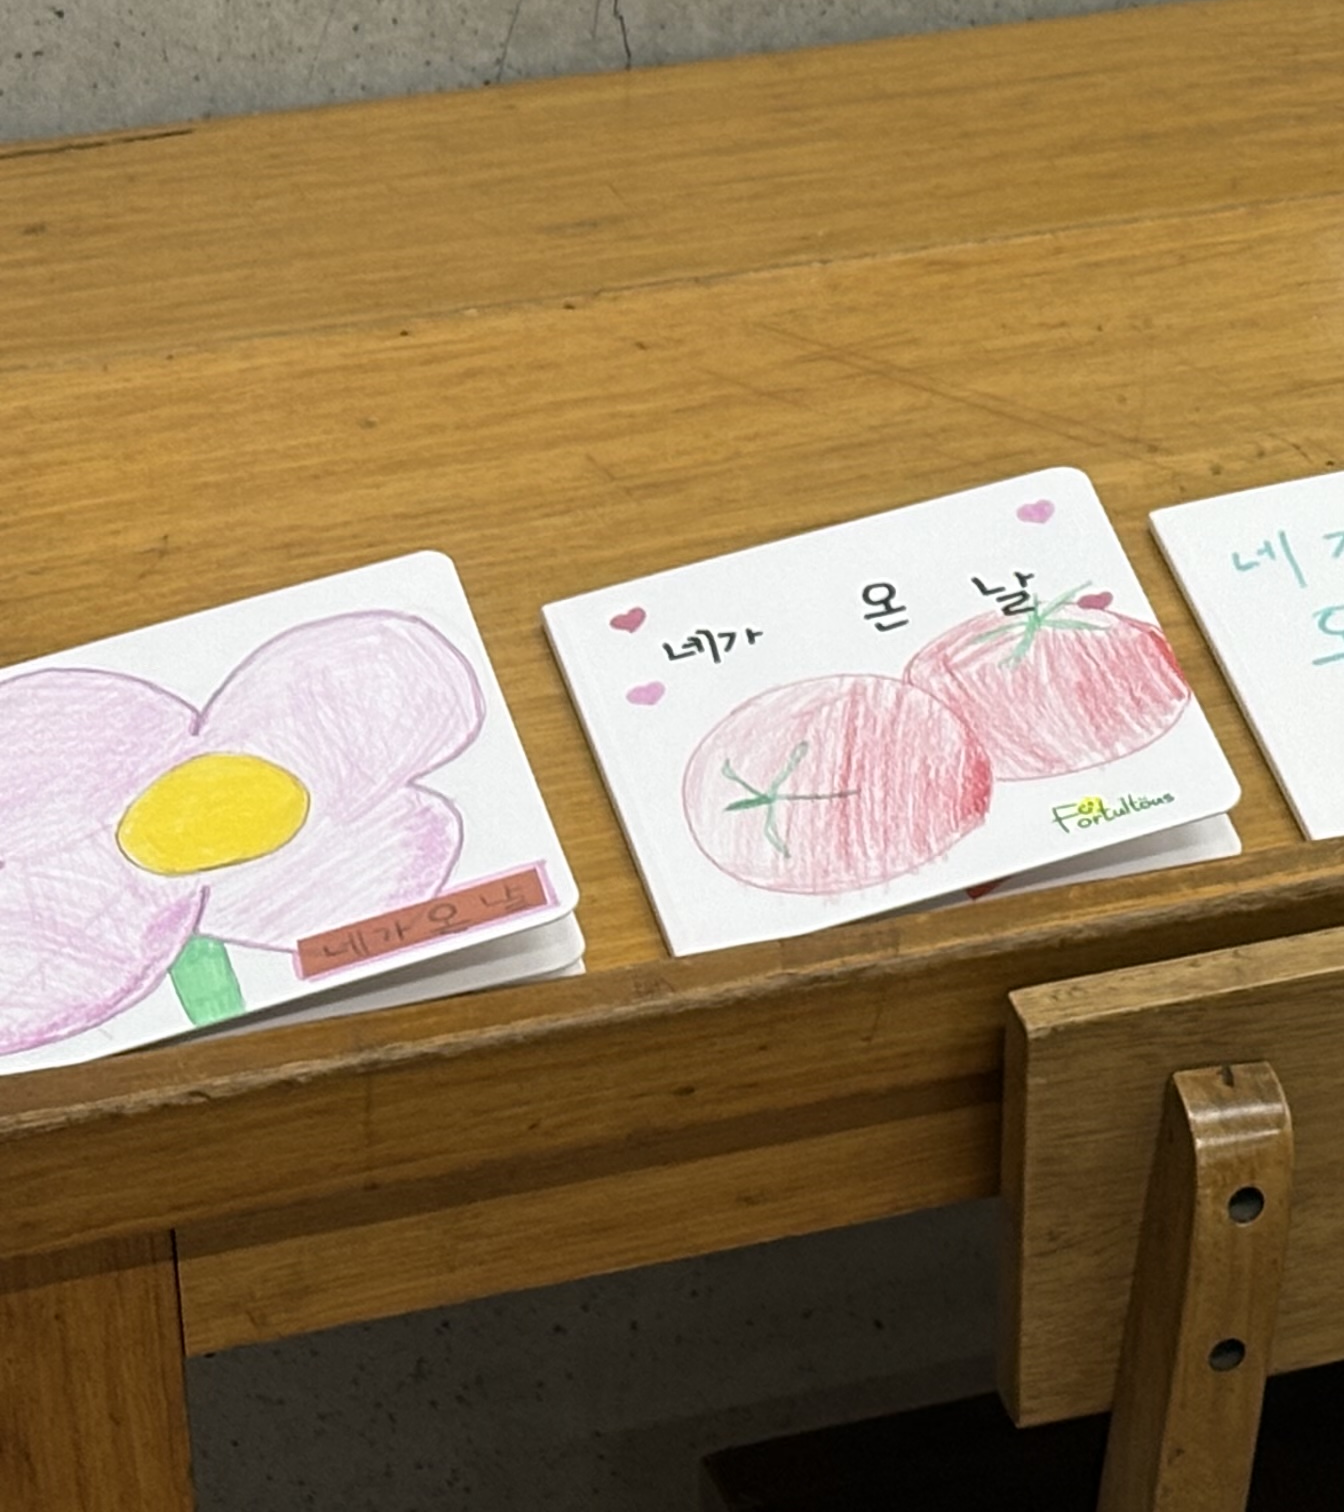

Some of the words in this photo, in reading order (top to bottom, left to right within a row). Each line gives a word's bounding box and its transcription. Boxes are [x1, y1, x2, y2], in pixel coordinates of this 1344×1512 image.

[663, 626, 764, 665] 네가
[860, 578, 909, 631] 온
[970, 571, 1038, 618] 날
[322, 924, 408, 960] 네가
